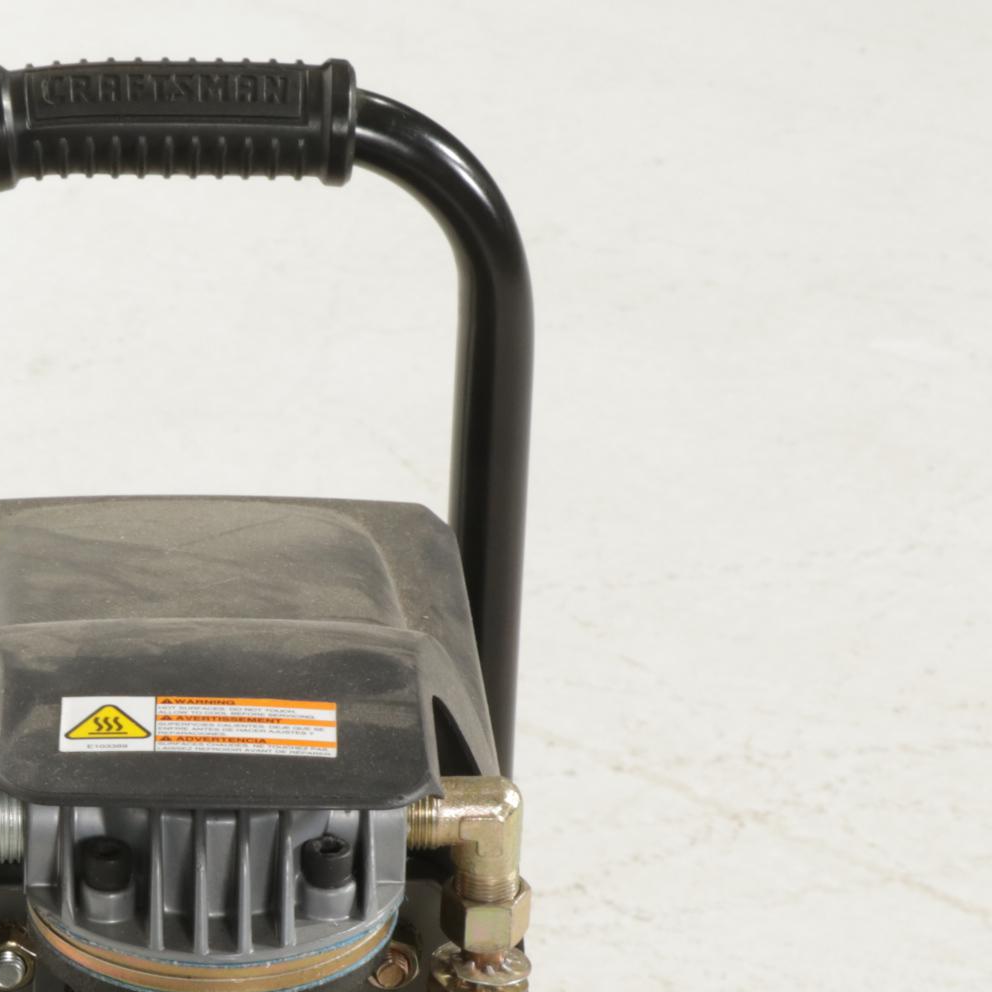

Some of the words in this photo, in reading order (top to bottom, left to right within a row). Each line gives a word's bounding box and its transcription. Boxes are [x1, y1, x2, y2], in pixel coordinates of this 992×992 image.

[41, 72, 290, 105] CRAFTSMAN
[176, 715, 282, 723] AVERTISSEMENT
[176, 736, 266, 744] ADVERTENCIA
